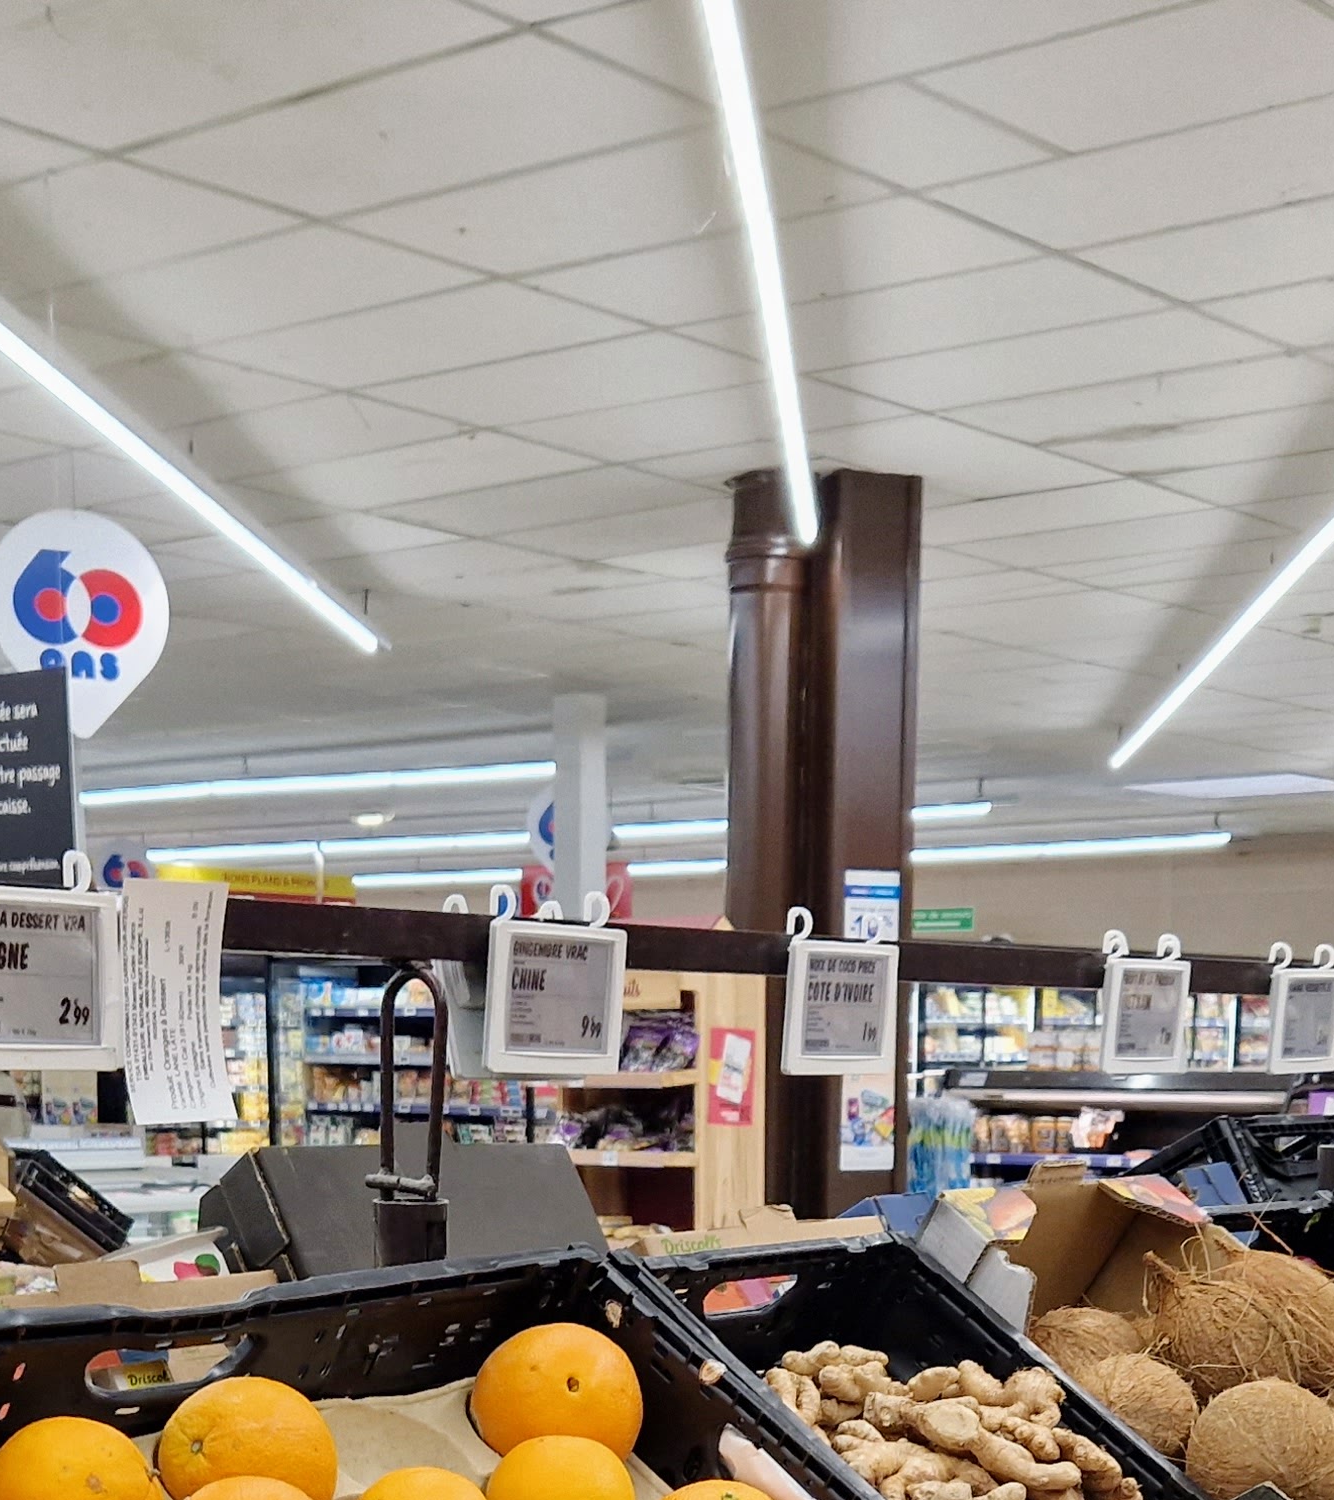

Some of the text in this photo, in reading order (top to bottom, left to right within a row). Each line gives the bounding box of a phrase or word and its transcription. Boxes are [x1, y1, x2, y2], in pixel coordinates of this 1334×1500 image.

[12, 548, 144, 650] 60
[13, 702, 39, 719] sera
[19, 763, 61, 789] passage
[0, 913, 8, 928] A
[11, 912, 58, 931] DESSERT
[566, 944, 588, 961] VRAC
[511, 967, 547, 991] CHINE
[808, 981, 831, 1002] COTE
